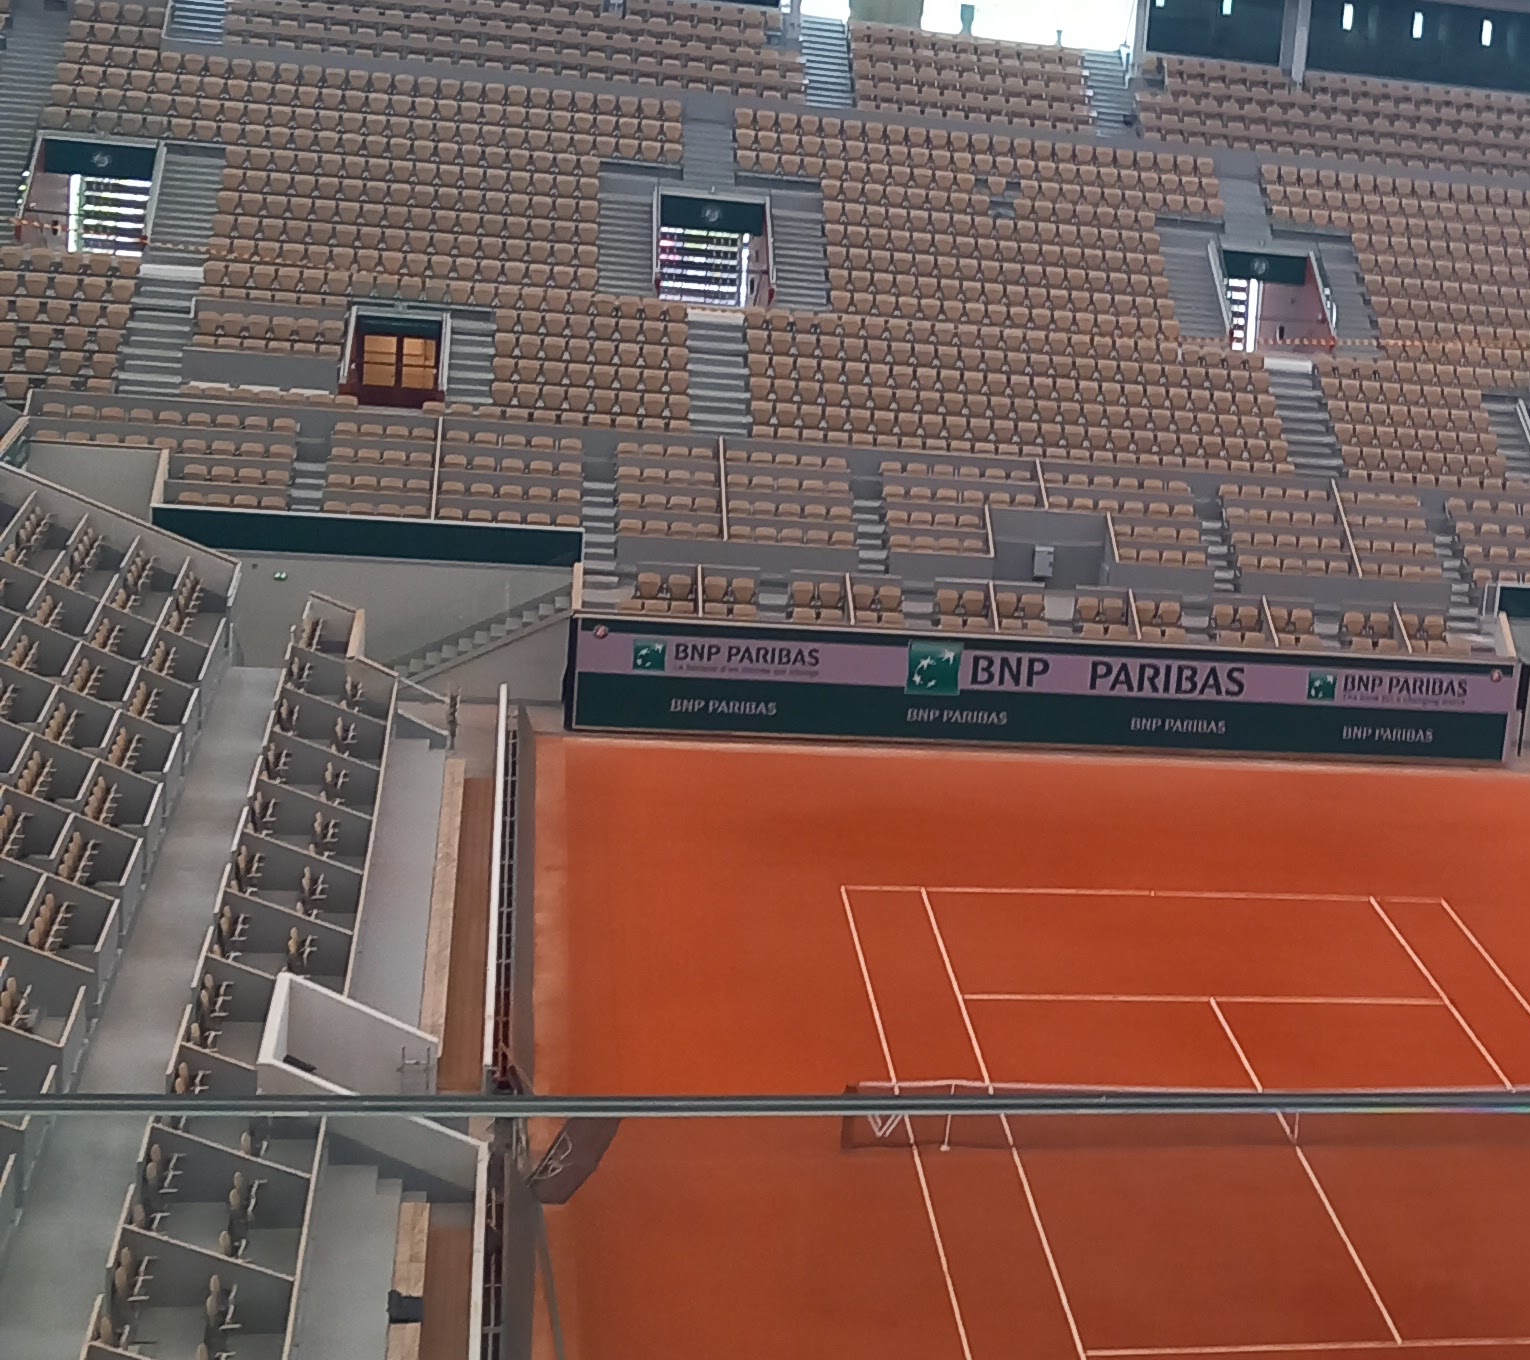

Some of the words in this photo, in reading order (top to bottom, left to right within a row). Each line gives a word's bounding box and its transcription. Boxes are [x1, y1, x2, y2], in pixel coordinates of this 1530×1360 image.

[674, 643, 721, 661] BNP
[726, 645, 820, 667] PARIBAS
[970, 654, 1051, 688] BNP
[1088, 660, 1247, 697] PARIBAS
[1343, 674, 1384, 694] BNP
[1388, 676, 1468, 698] PARIBAS
[670, 698, 705, 712] BNP
[708, 699, 777, 716] PARIBAS
[906, 707, 940, 722] BNP
[942, 709, 1008, 725] PARIBAS
[1131, 716, 1162, 731] BNP
[1164, 718, 1226, 734] PARIBAS
[1342, 725, 1371, 740] BNP
